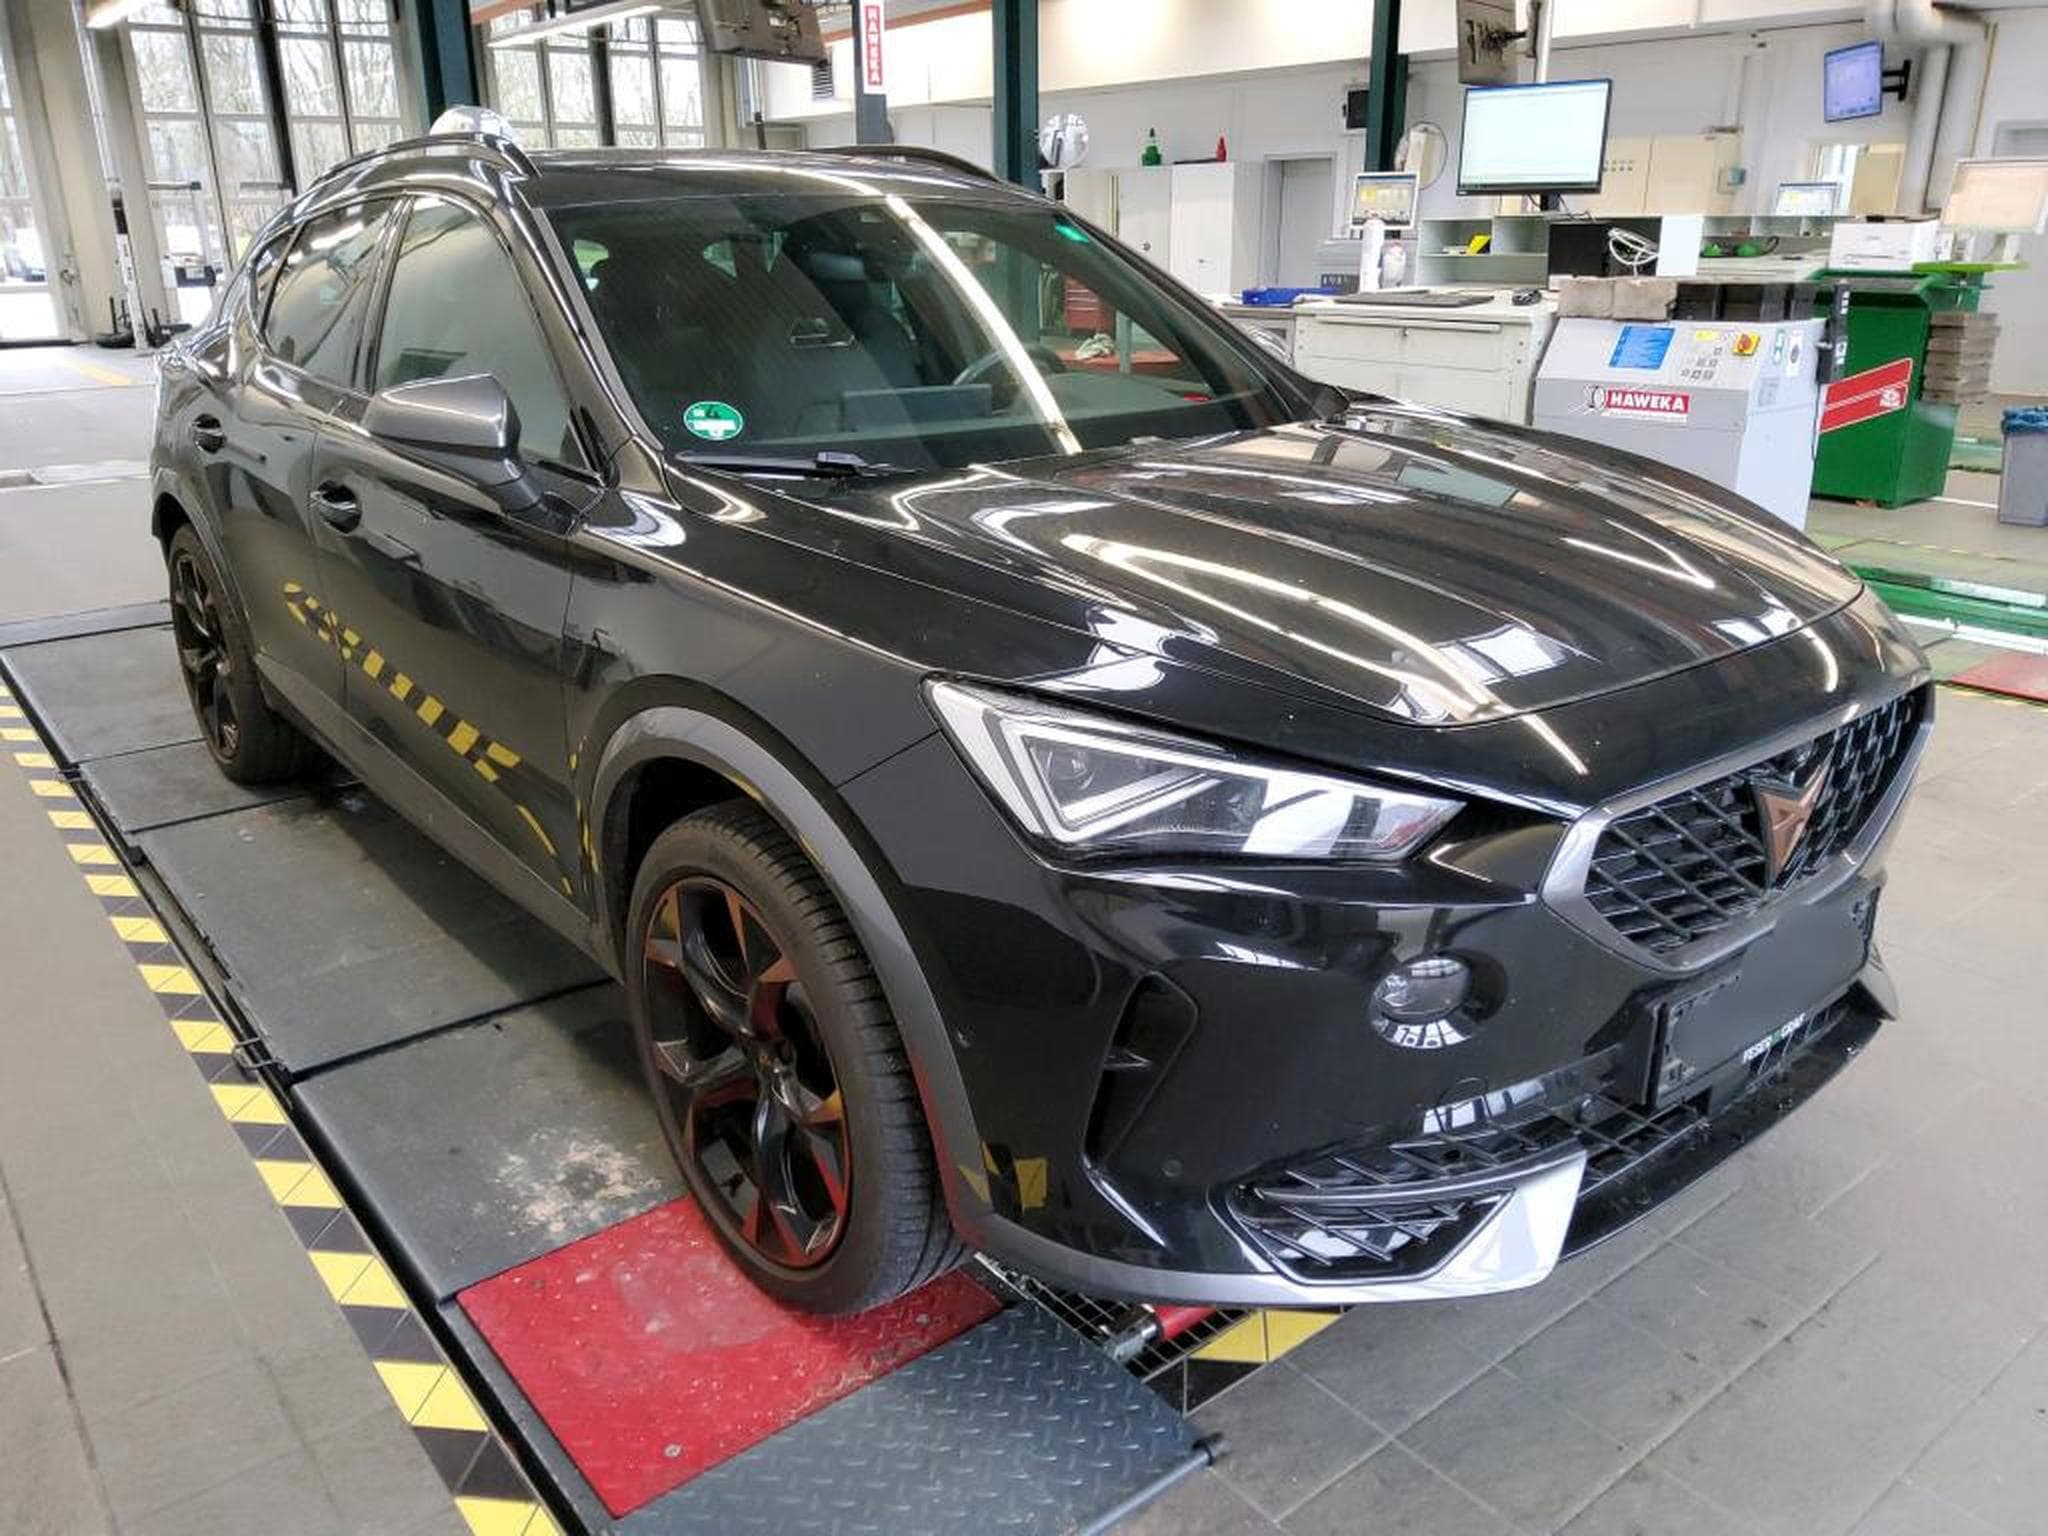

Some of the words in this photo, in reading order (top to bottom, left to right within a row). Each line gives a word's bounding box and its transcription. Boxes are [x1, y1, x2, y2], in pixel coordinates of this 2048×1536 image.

[867, 7, 881, 83] HAWEKA
[705, 404, 720, 418] 4
[1609, 390, 1686, 411] HAWEKA
